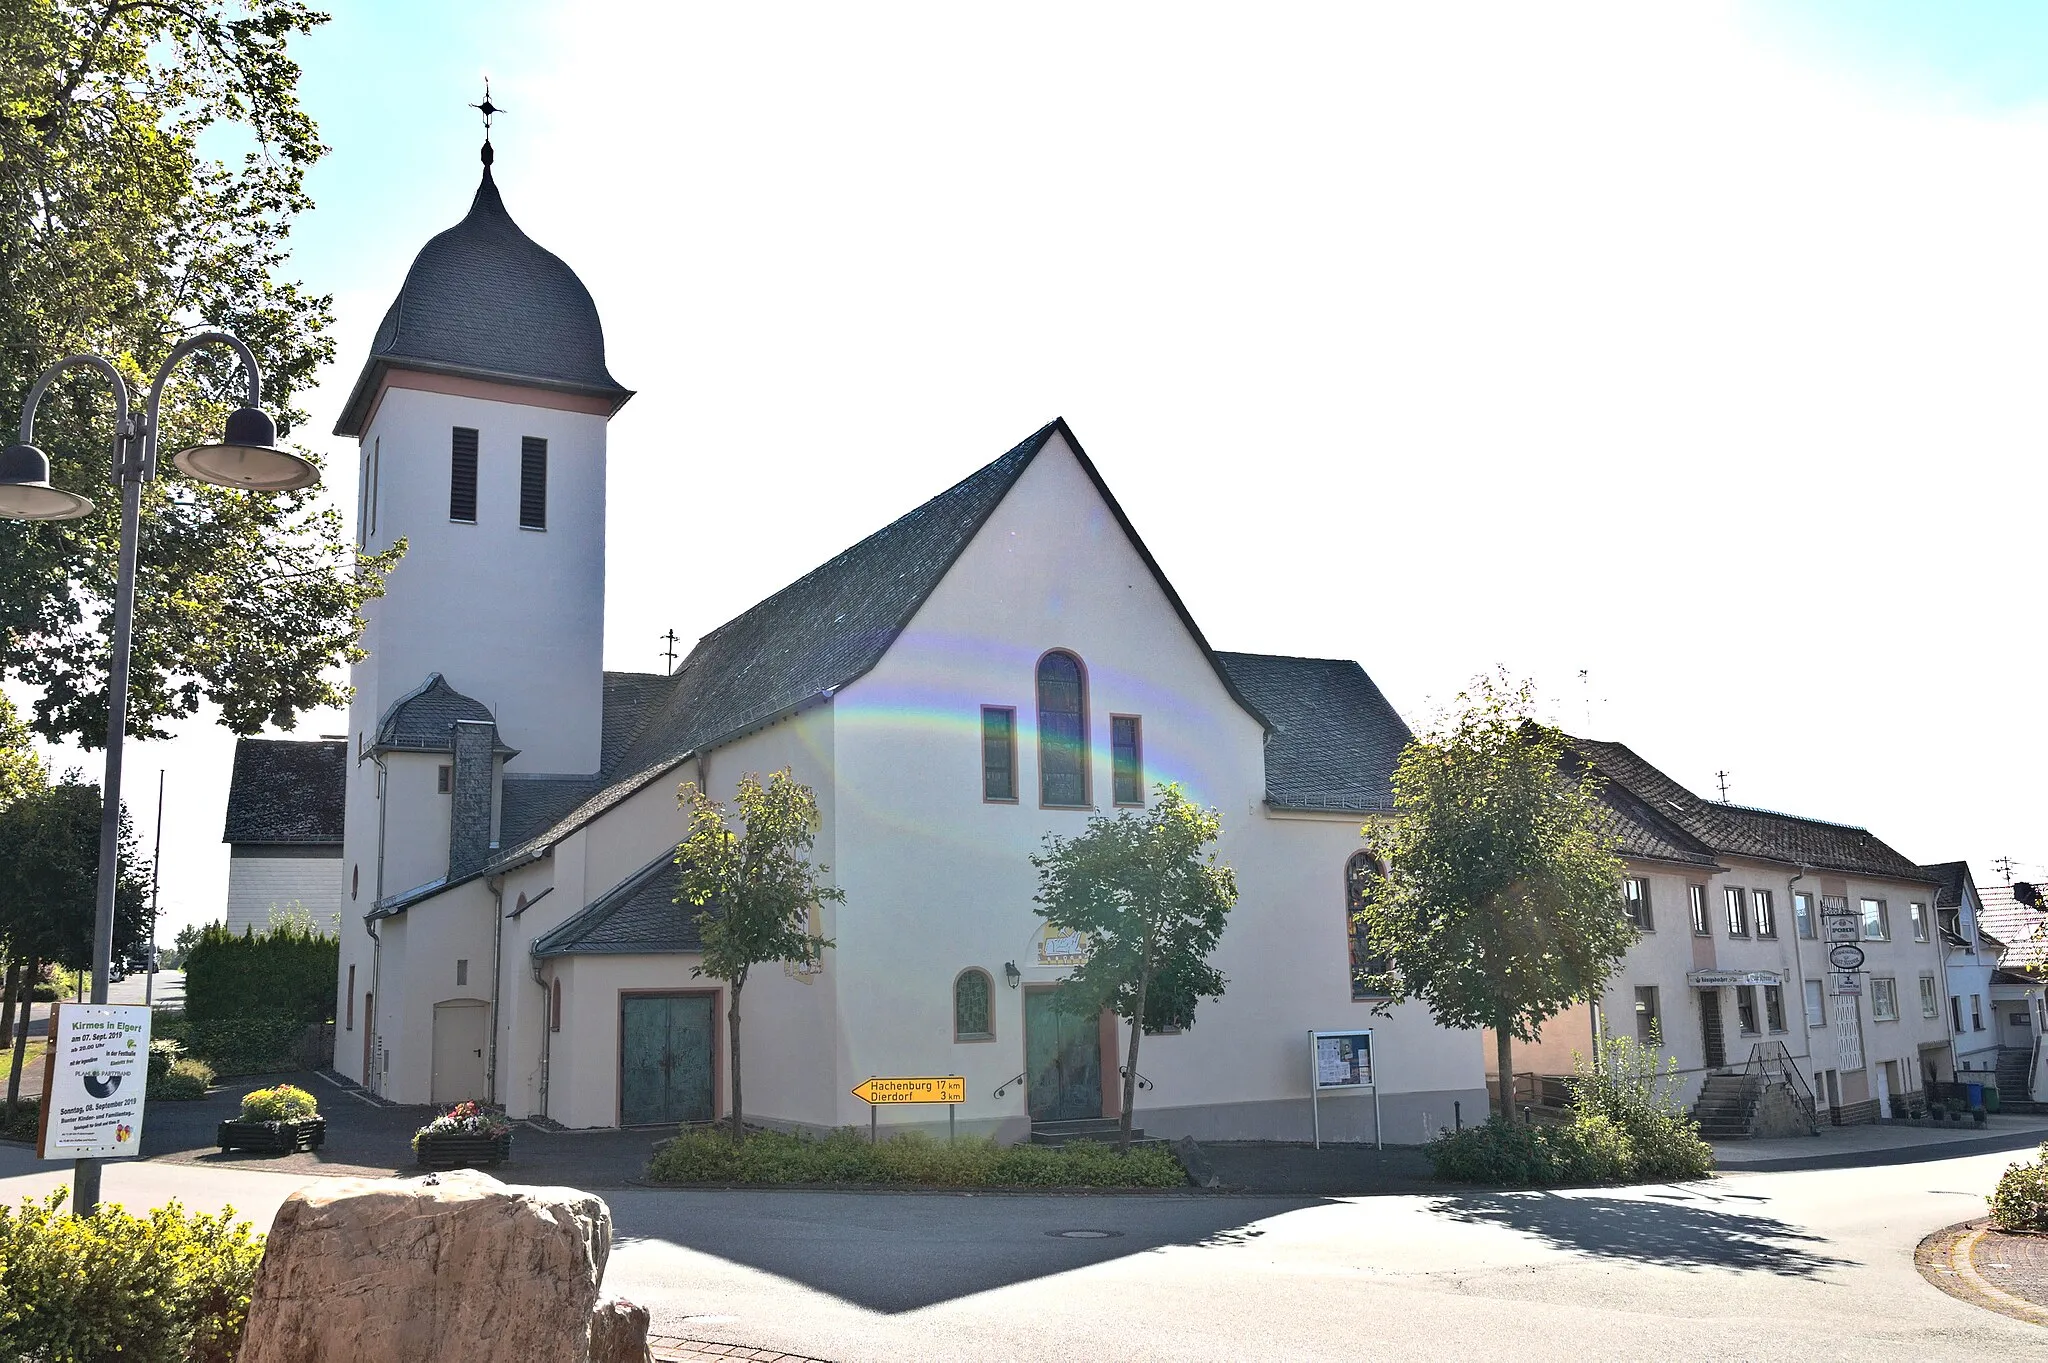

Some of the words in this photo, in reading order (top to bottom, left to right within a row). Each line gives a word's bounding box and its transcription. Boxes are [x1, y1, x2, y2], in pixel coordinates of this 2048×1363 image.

[72, 1022, 104, 1030] Kirmes
[117, 1022, 142, 1032] Elgert
[871, 1081, 932, 1092] Hachenburg
[936, 1081, 946, 1089] 17
[871, 1092, 912, 1101] Dierdorf
[941, 1091, 946, 1100] 3
[60, 1107, 84, 1115] Sonntag,
[95, 1101, 123, 1110] September
